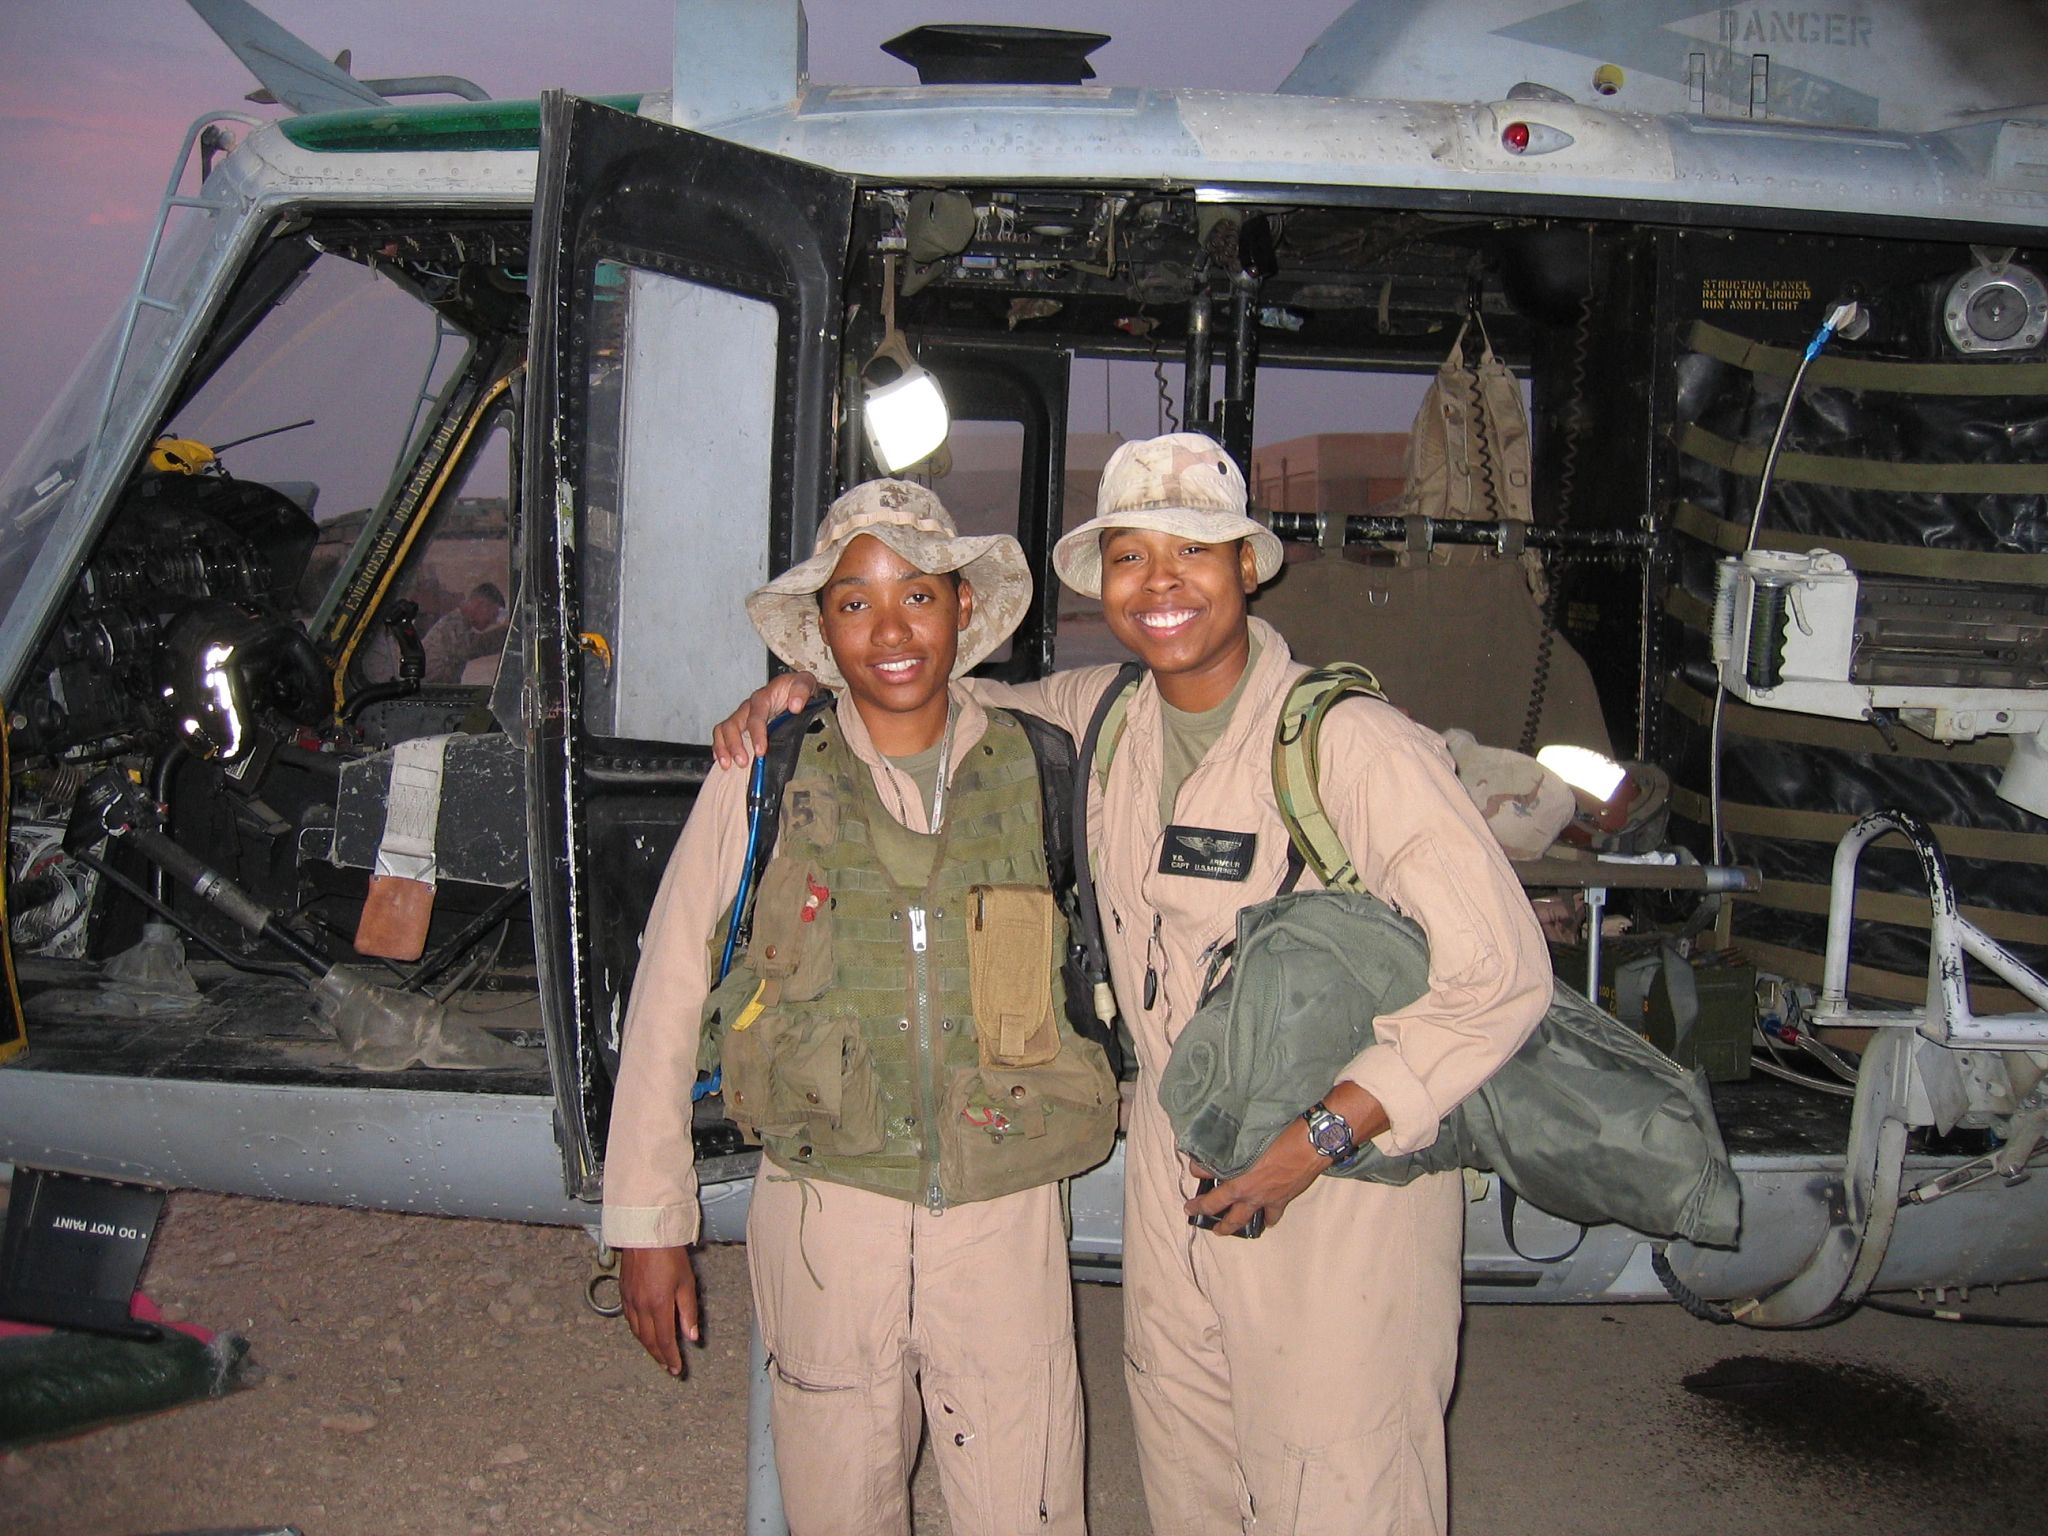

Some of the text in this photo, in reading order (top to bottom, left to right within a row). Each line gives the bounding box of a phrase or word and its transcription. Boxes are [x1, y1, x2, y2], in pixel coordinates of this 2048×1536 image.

[1719, 10, 1872, 48] DANGER
[1772, 280, 1809, 290] PANEL
[1702, 289, 1812, 300] REQUIRED GROUND
[1702, 299, 1799, 310] RUN AND FLIGHT
[345, 414, 462, 611] EMERGENCY RELEASE PULL
[1171, 861, 1190, 870] CAPT
[1209, 858, 1241, 869] ARMOUR
[53, 1216, 137, 1239] DO NOT PAINT
